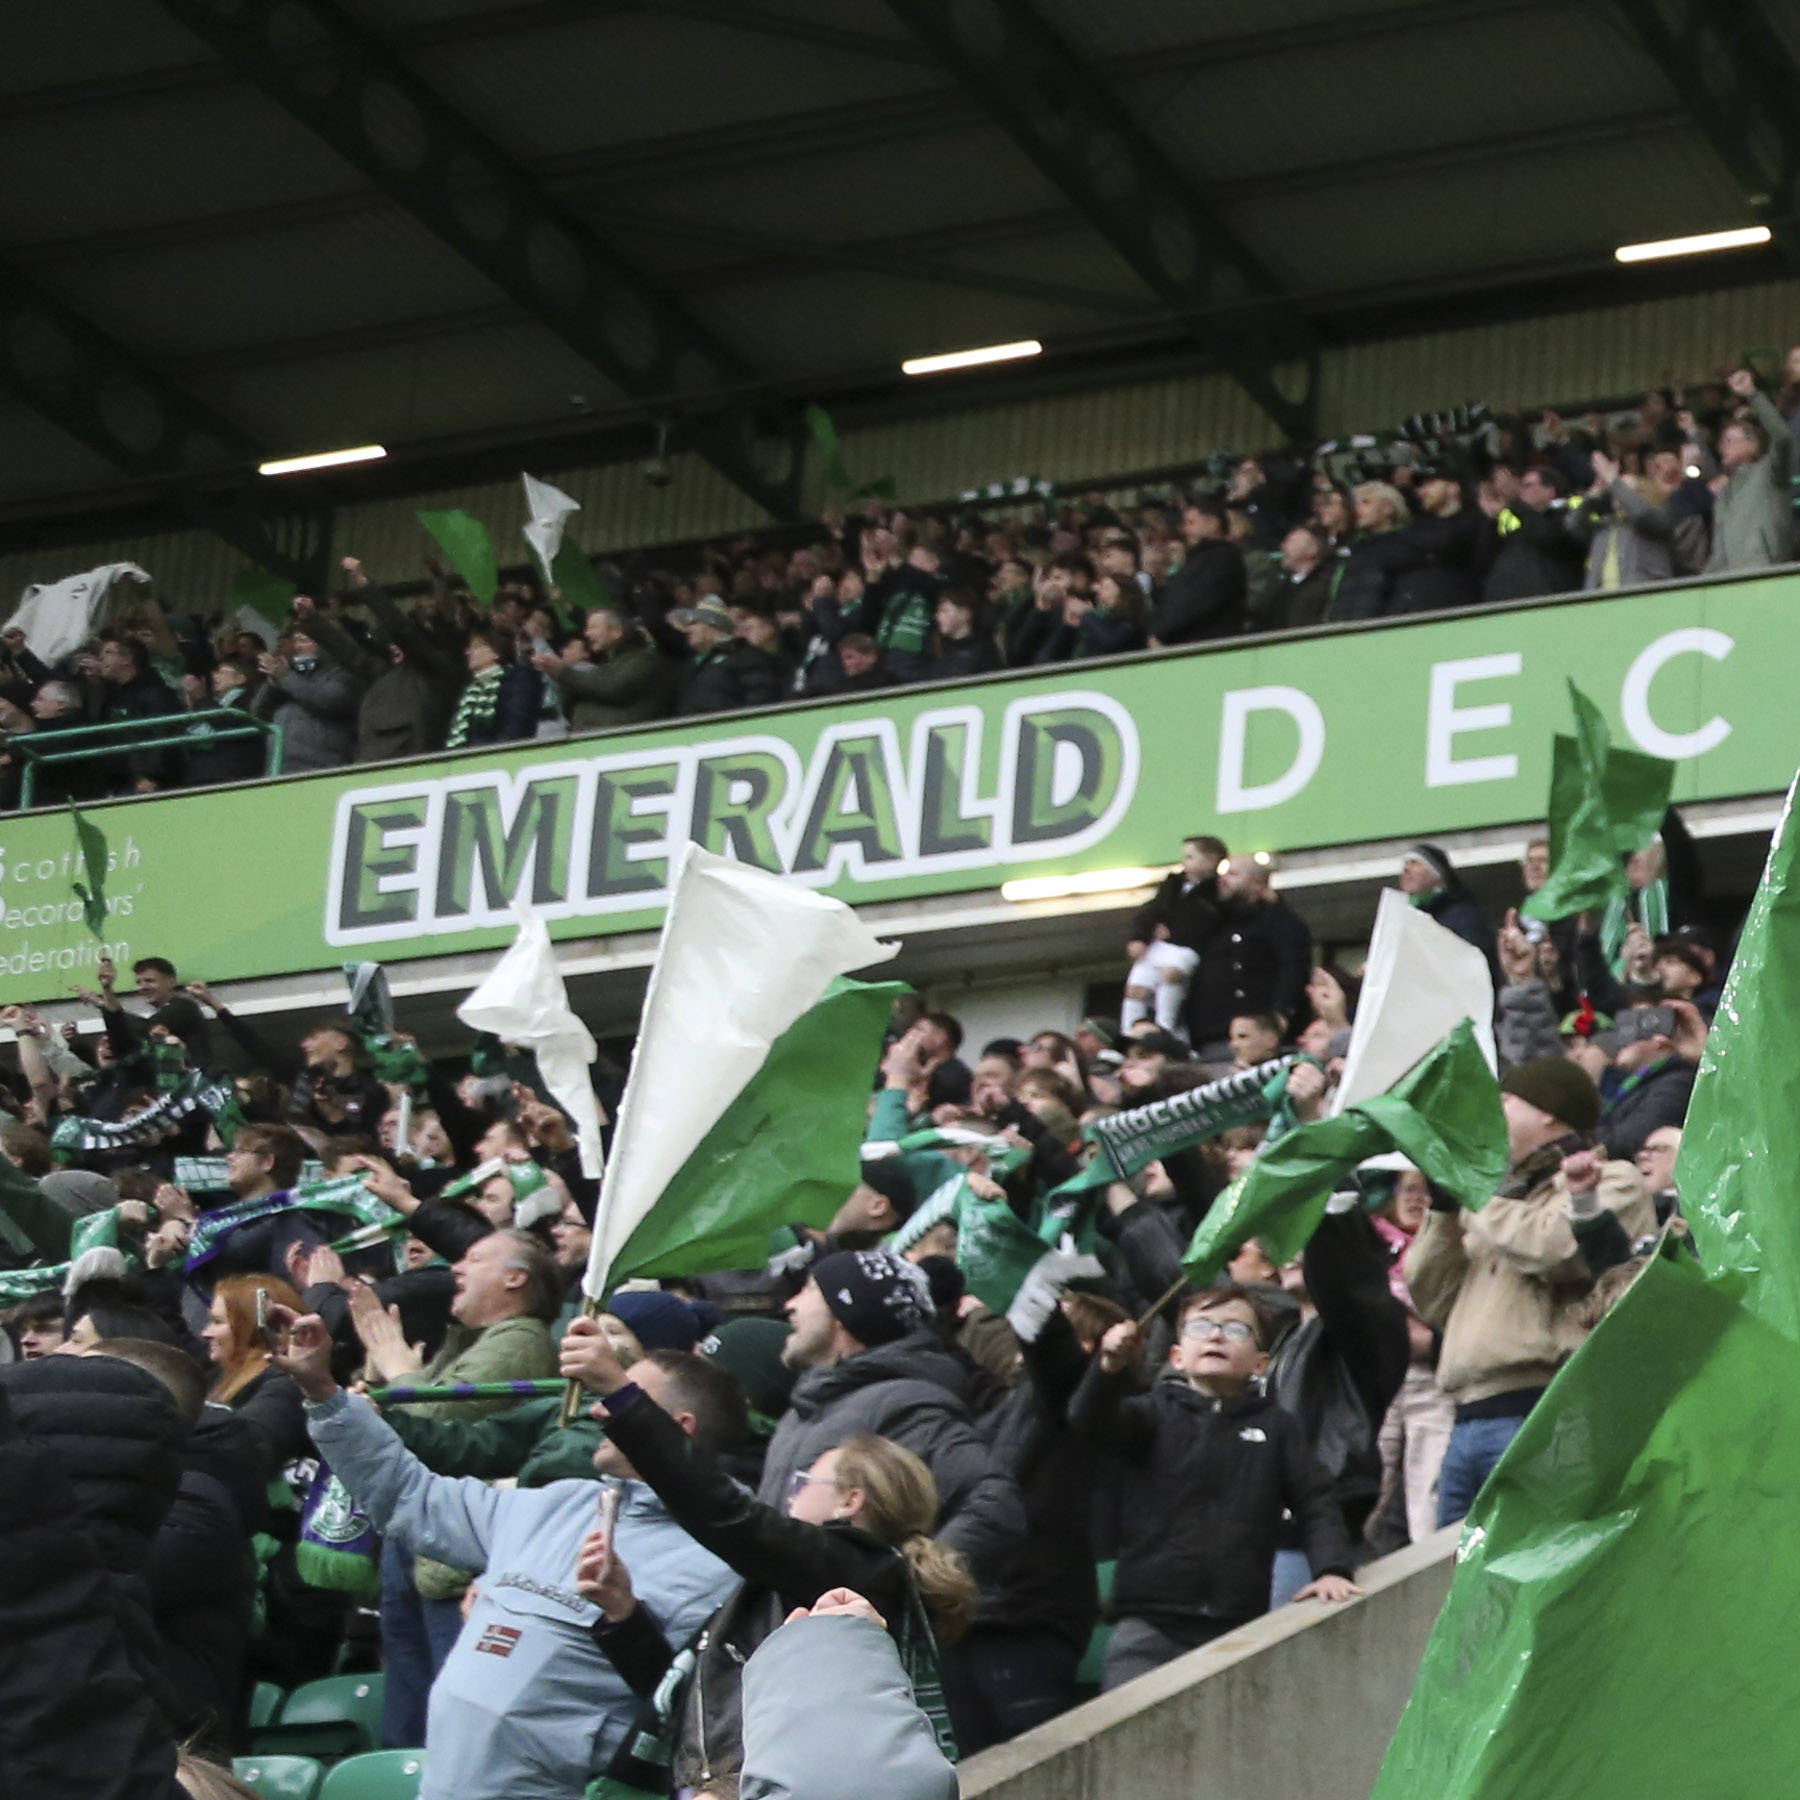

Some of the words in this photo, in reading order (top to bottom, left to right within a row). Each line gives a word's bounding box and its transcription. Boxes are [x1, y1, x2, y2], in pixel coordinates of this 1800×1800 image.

[330, 695, 1137, 942] EMERALD
[0, 836, 141, 882] cottsh
[0, 938, 130, 976] ederation
